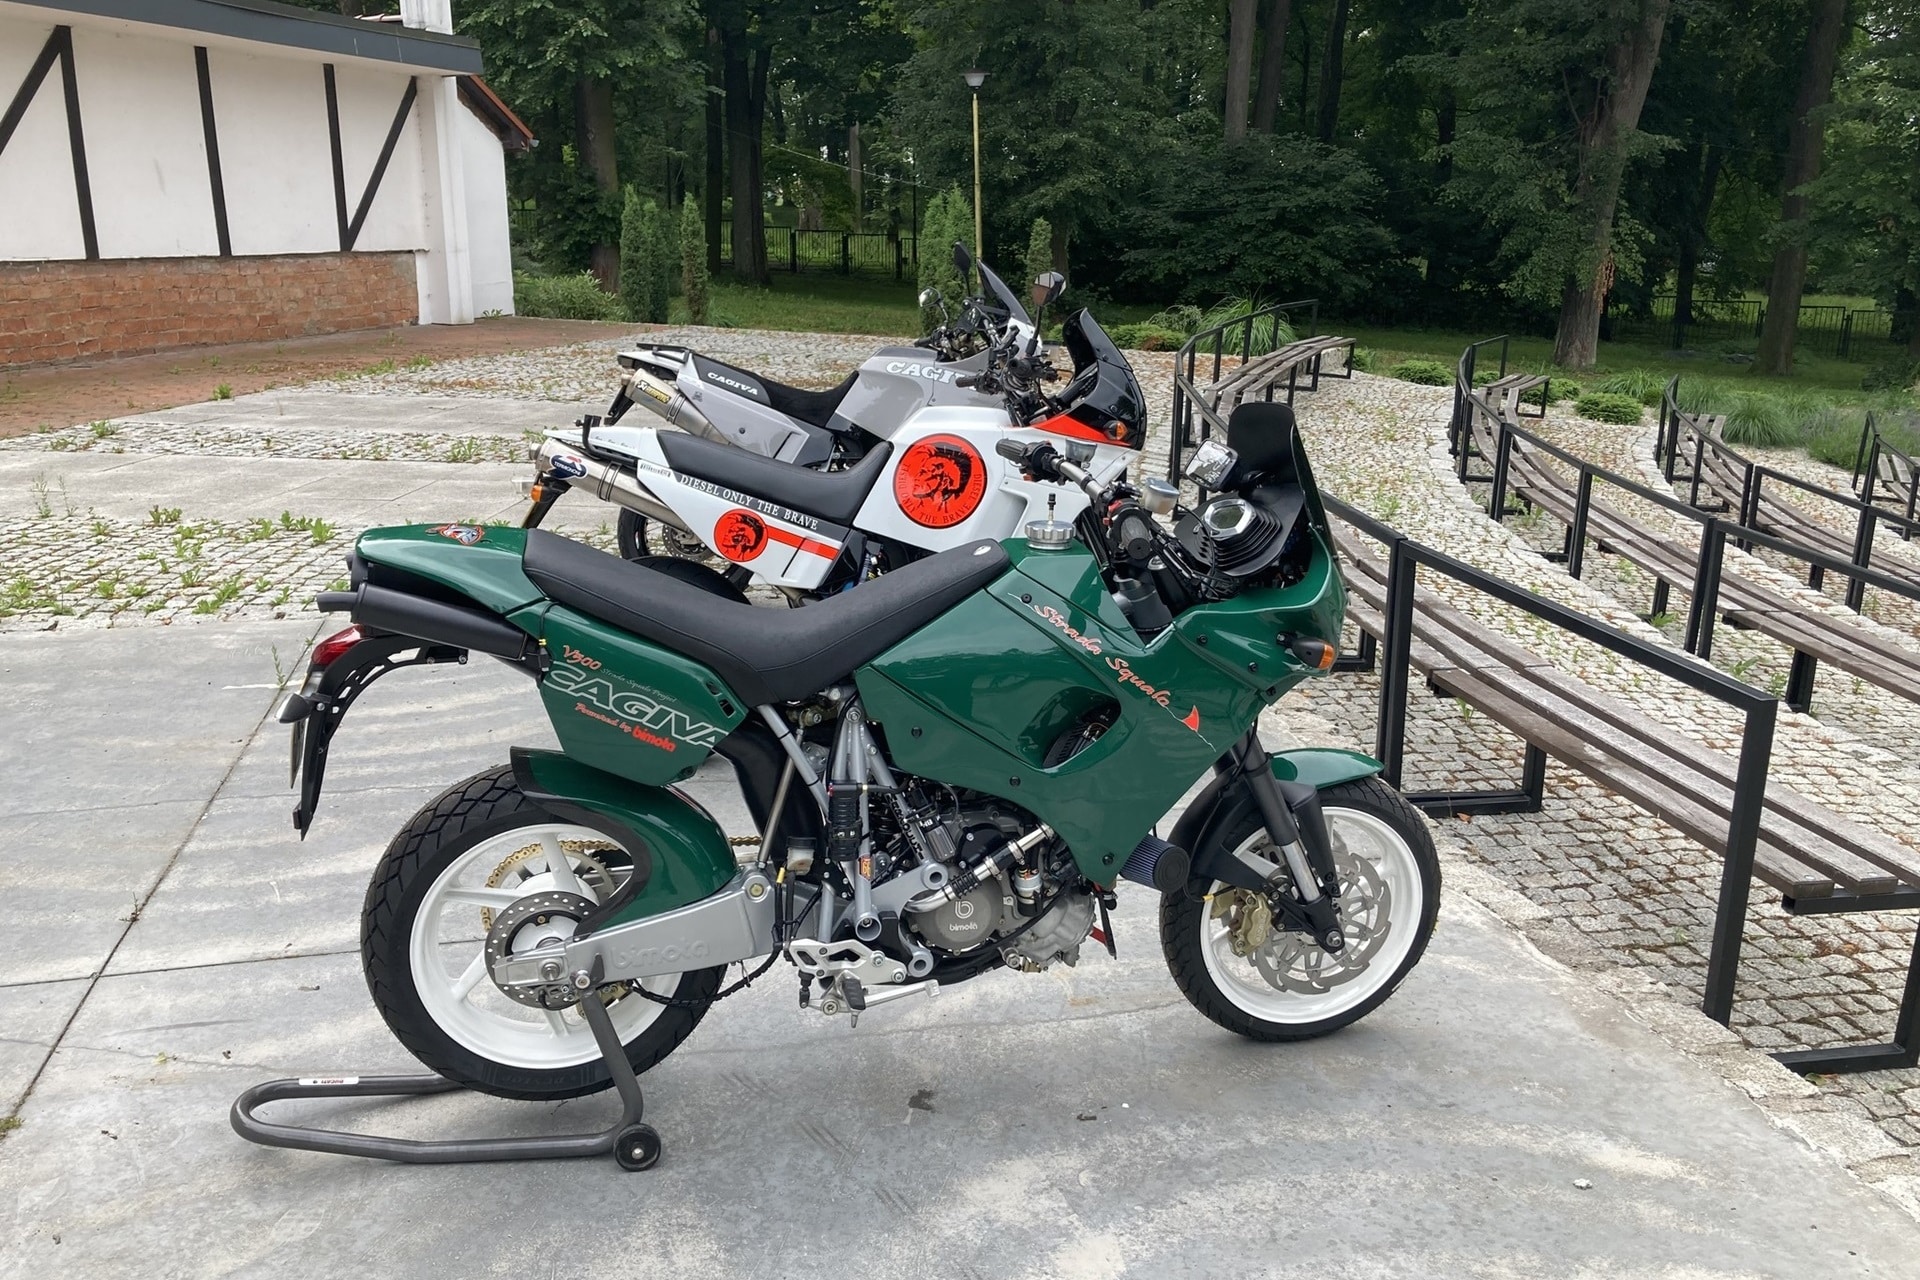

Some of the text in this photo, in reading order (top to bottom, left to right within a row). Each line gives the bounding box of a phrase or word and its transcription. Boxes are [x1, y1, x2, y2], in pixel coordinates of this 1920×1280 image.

[707, 372, 758, 395] CAGIVA
[886, 361, 977, 391] CAGI
[680, 475, 819, 530] DIESEL ONLY THE BRAVE
[901, 492, 919, 513] ONLY
[919, 512, 938, 524] THE
[943, 503, 970, 524] BRAVE
[970, 474, 982, 500] DIESEL
[563, 645, 602, 670] V500
[1034, 605, 1171, 706] Strada Squalo
[543, 661, 729, 748] CAGIVA
[632, 725, 676, 752] bimota
[949, 922, 978, 931] bimota
[610, 938, 710, 969] bimota
